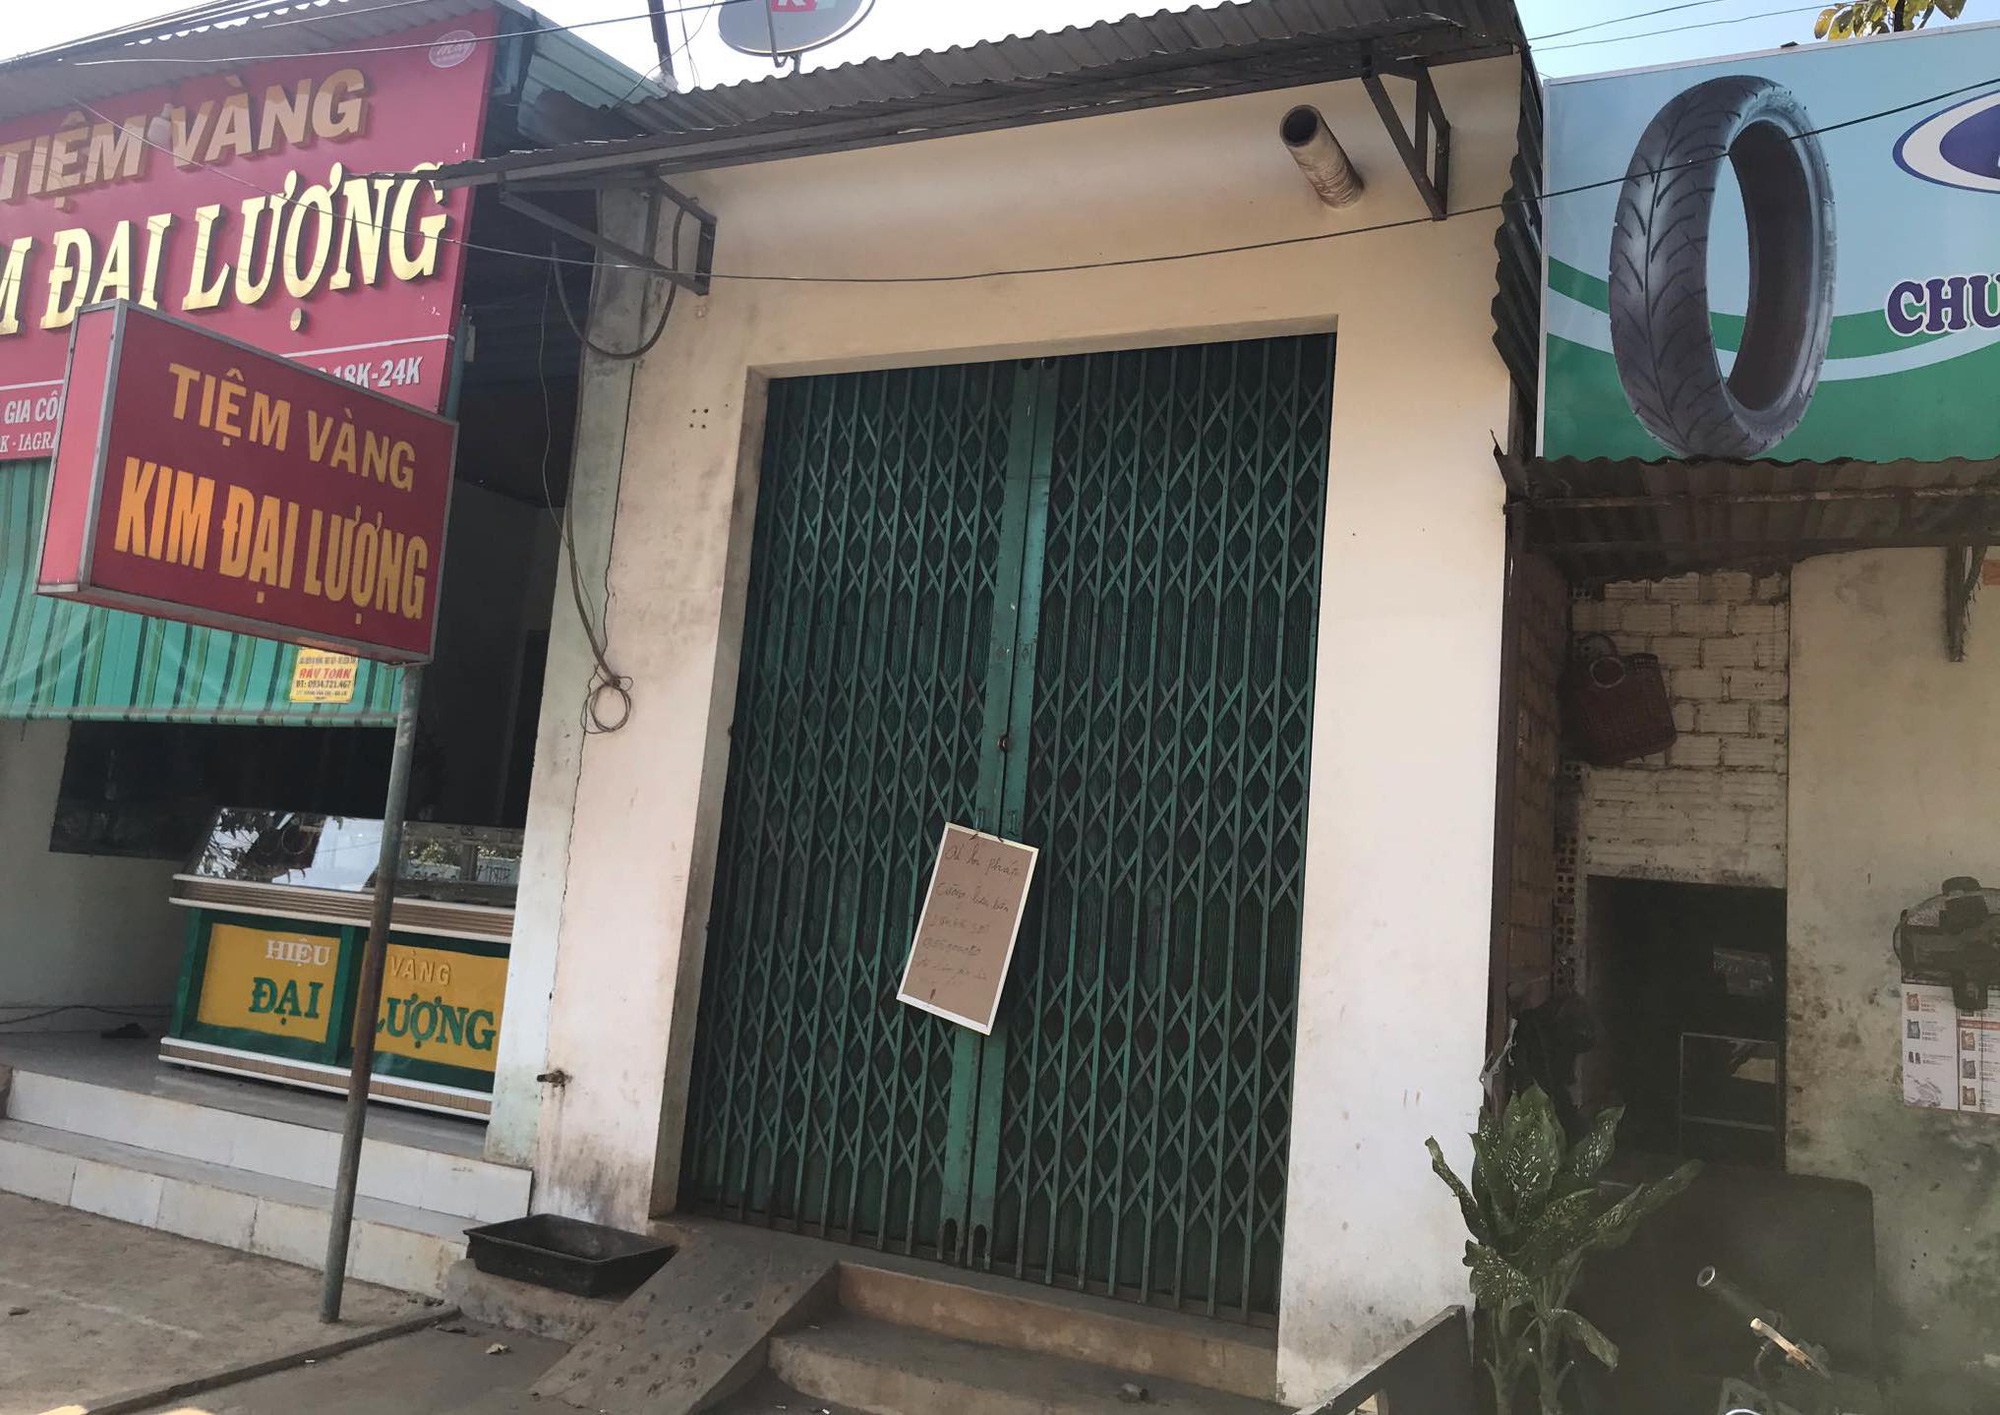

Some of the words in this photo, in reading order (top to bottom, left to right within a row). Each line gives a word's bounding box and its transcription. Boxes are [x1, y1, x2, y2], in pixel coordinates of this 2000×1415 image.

[0, 110, 148, 211] TIỆM
[170, 68, 369, 168] VÀNG
[182, 162, 449, 331] LƯỢNG
[4, 399, 31, 424] GIA
[35, 389, 62, 422] CÔ
[18, 431, 54, 451] IAGR
[168, 363, 291, 451] TIỆM
[307, 407, 417, 492] VÀNG
[114, 456, 216, 570] KIM
[219, 485, 300, 604] ĐẠI
[304, 505, 429, 625] LƯỢNG
[265, 937, 331, 967] HIỆU
[390, 950, 451, 986] VÀNG
[248, 976, 324, 1026] ĐẠI
[376, 992, 497, 1052] ƯỢNG
